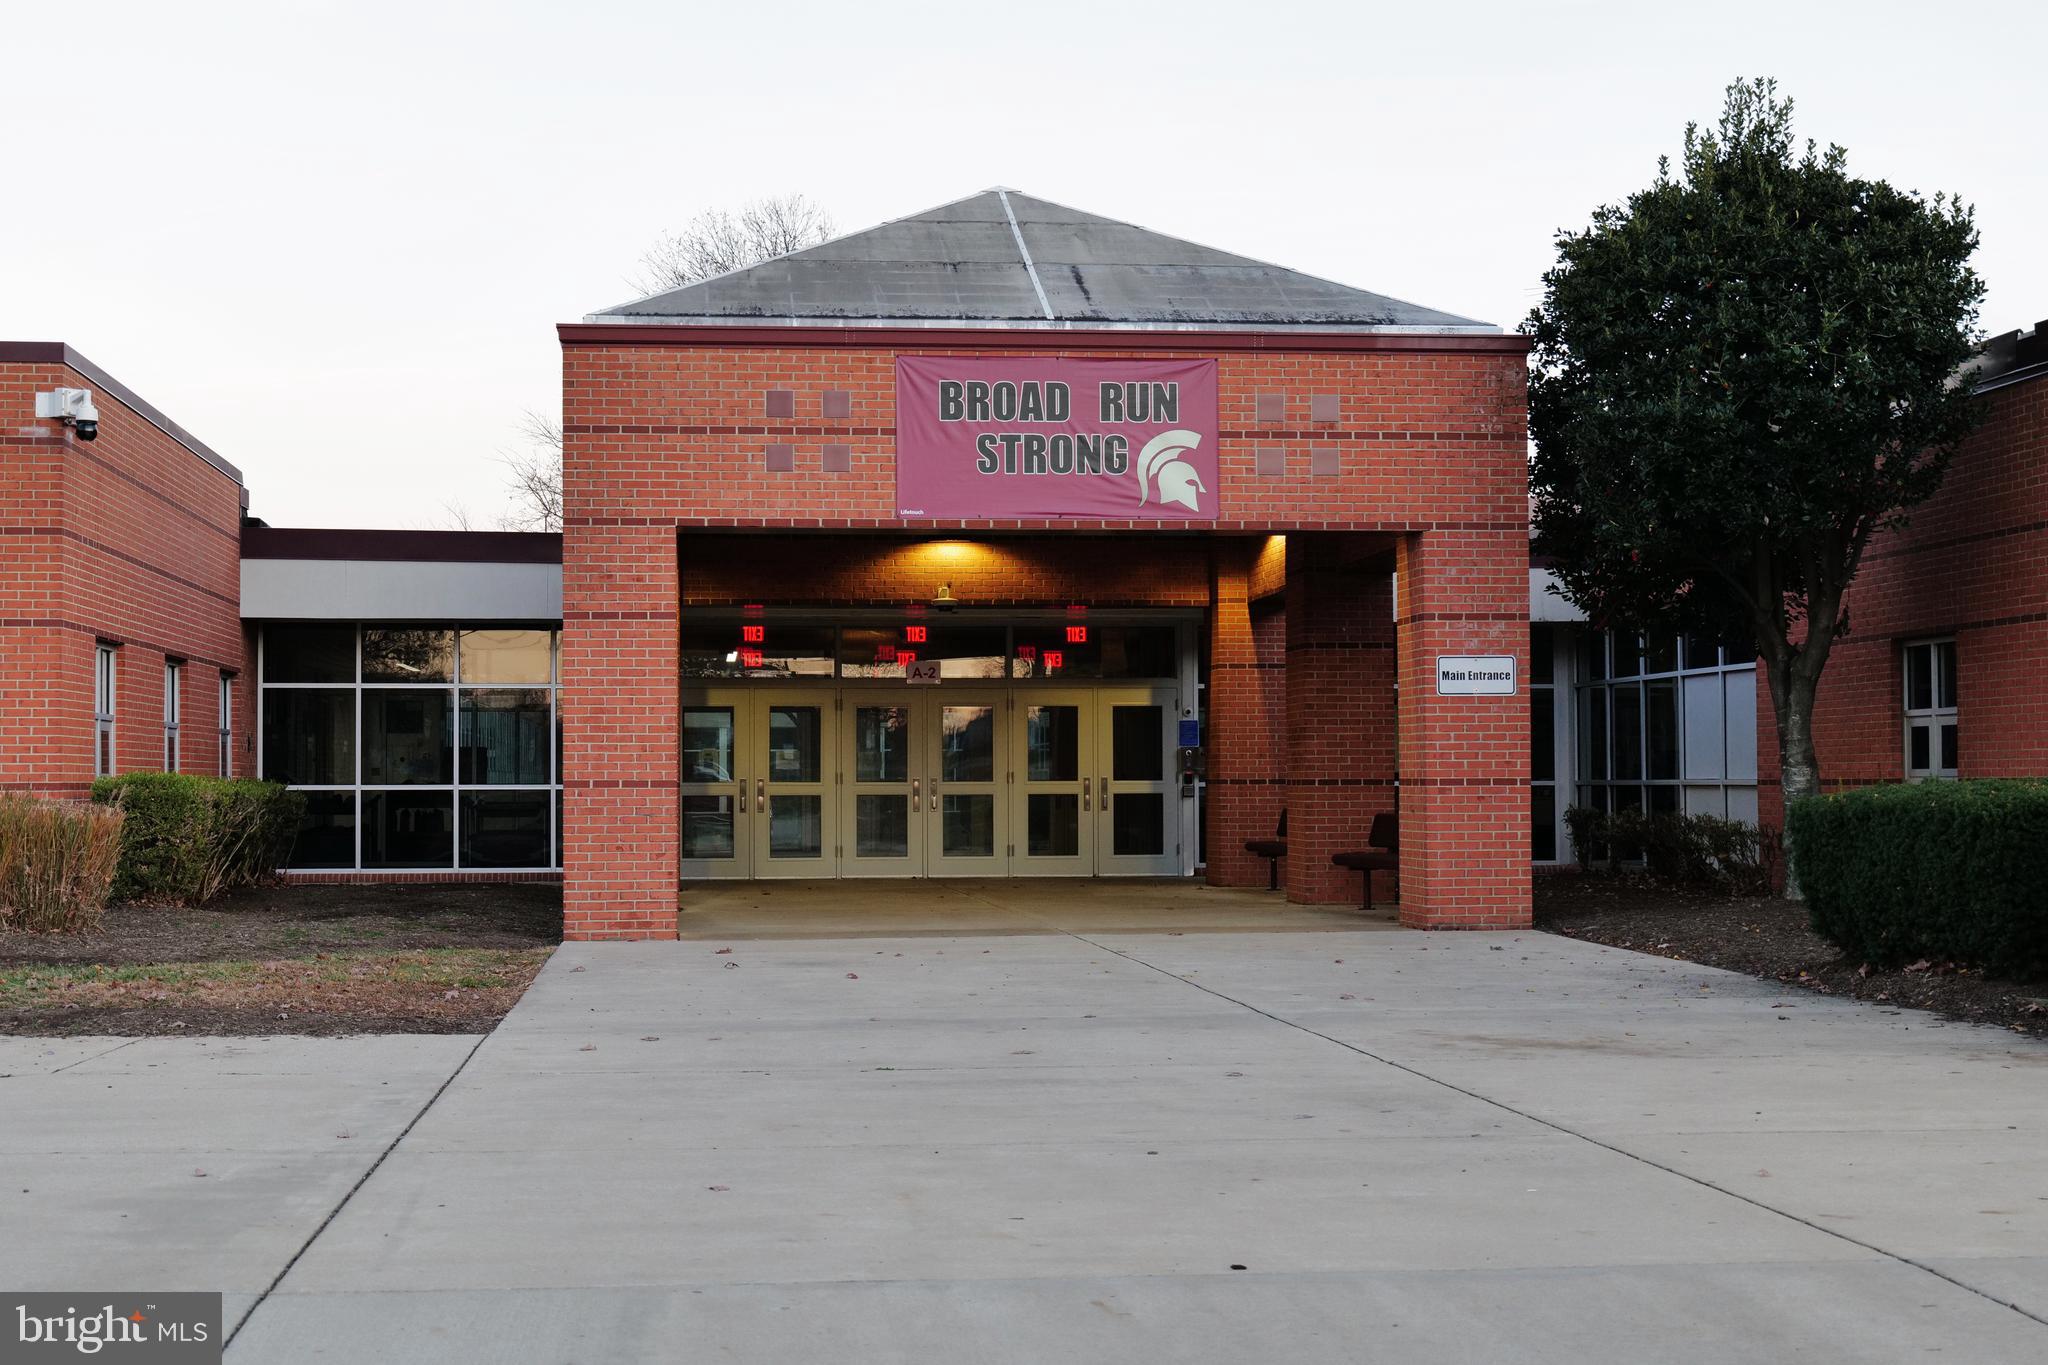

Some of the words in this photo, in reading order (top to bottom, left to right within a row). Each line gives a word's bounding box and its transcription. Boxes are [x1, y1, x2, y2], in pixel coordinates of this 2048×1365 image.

[938, 380, 1071, 423] BROAD
[1099, 381, 1179, 423] RUN
[976, 432, 1129, 475] STRONG
[912, 667, 936, 679] A-2
[1441, 670, 1466, 681] Main
[1468, 670, 1511, 681] Entrance
